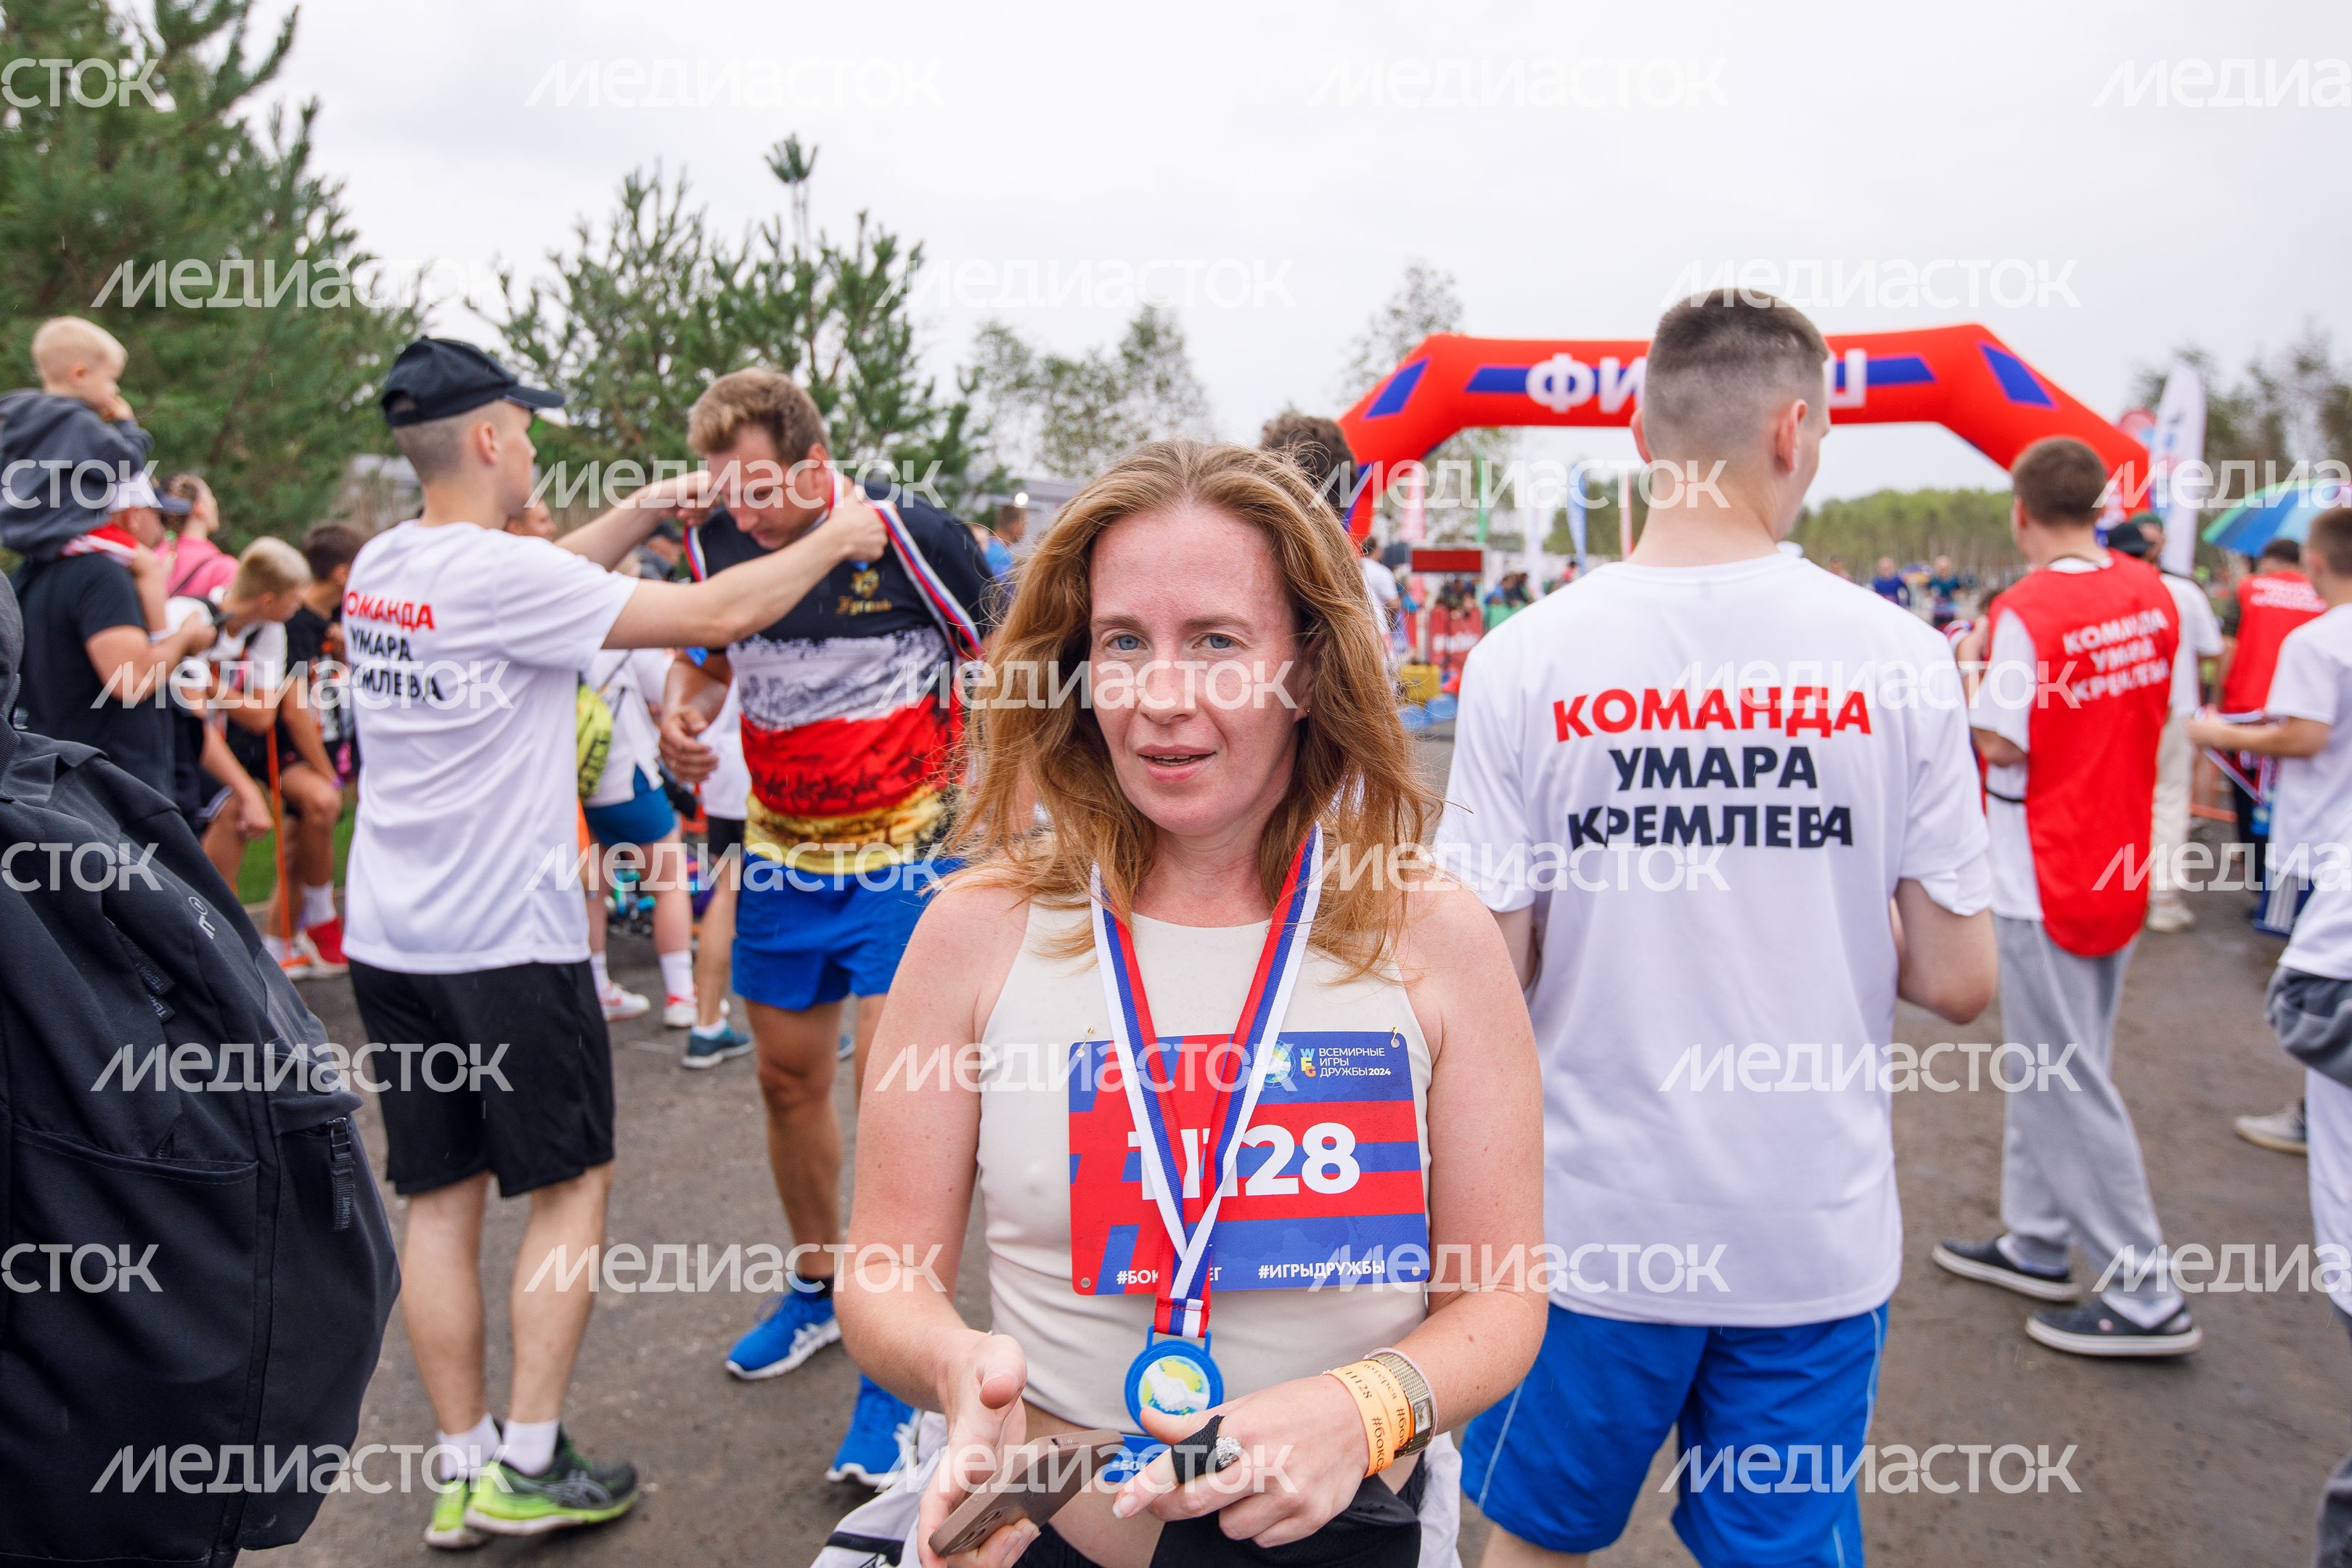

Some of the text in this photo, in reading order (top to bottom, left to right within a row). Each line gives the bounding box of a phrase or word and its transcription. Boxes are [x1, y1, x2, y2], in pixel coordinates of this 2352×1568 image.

[343, 589, 436, 633] ОМАНДА
[349, 624, 415, 661] УМАРА
[1552, 685, 1872, 743] КОМАНДА
[1609, 746, 1818, 791] УМАРА
[1568, 805, 1853, 851] КРЕМЛЕВА
[1318, 1048, 1385, 1057] ВСЕМИРНЫЕ
[1319, 1058, 1349, 1066] ИГРЫ
[1258, 1260, 1386, 1281] #ИГРЫДРУЖБЫ
